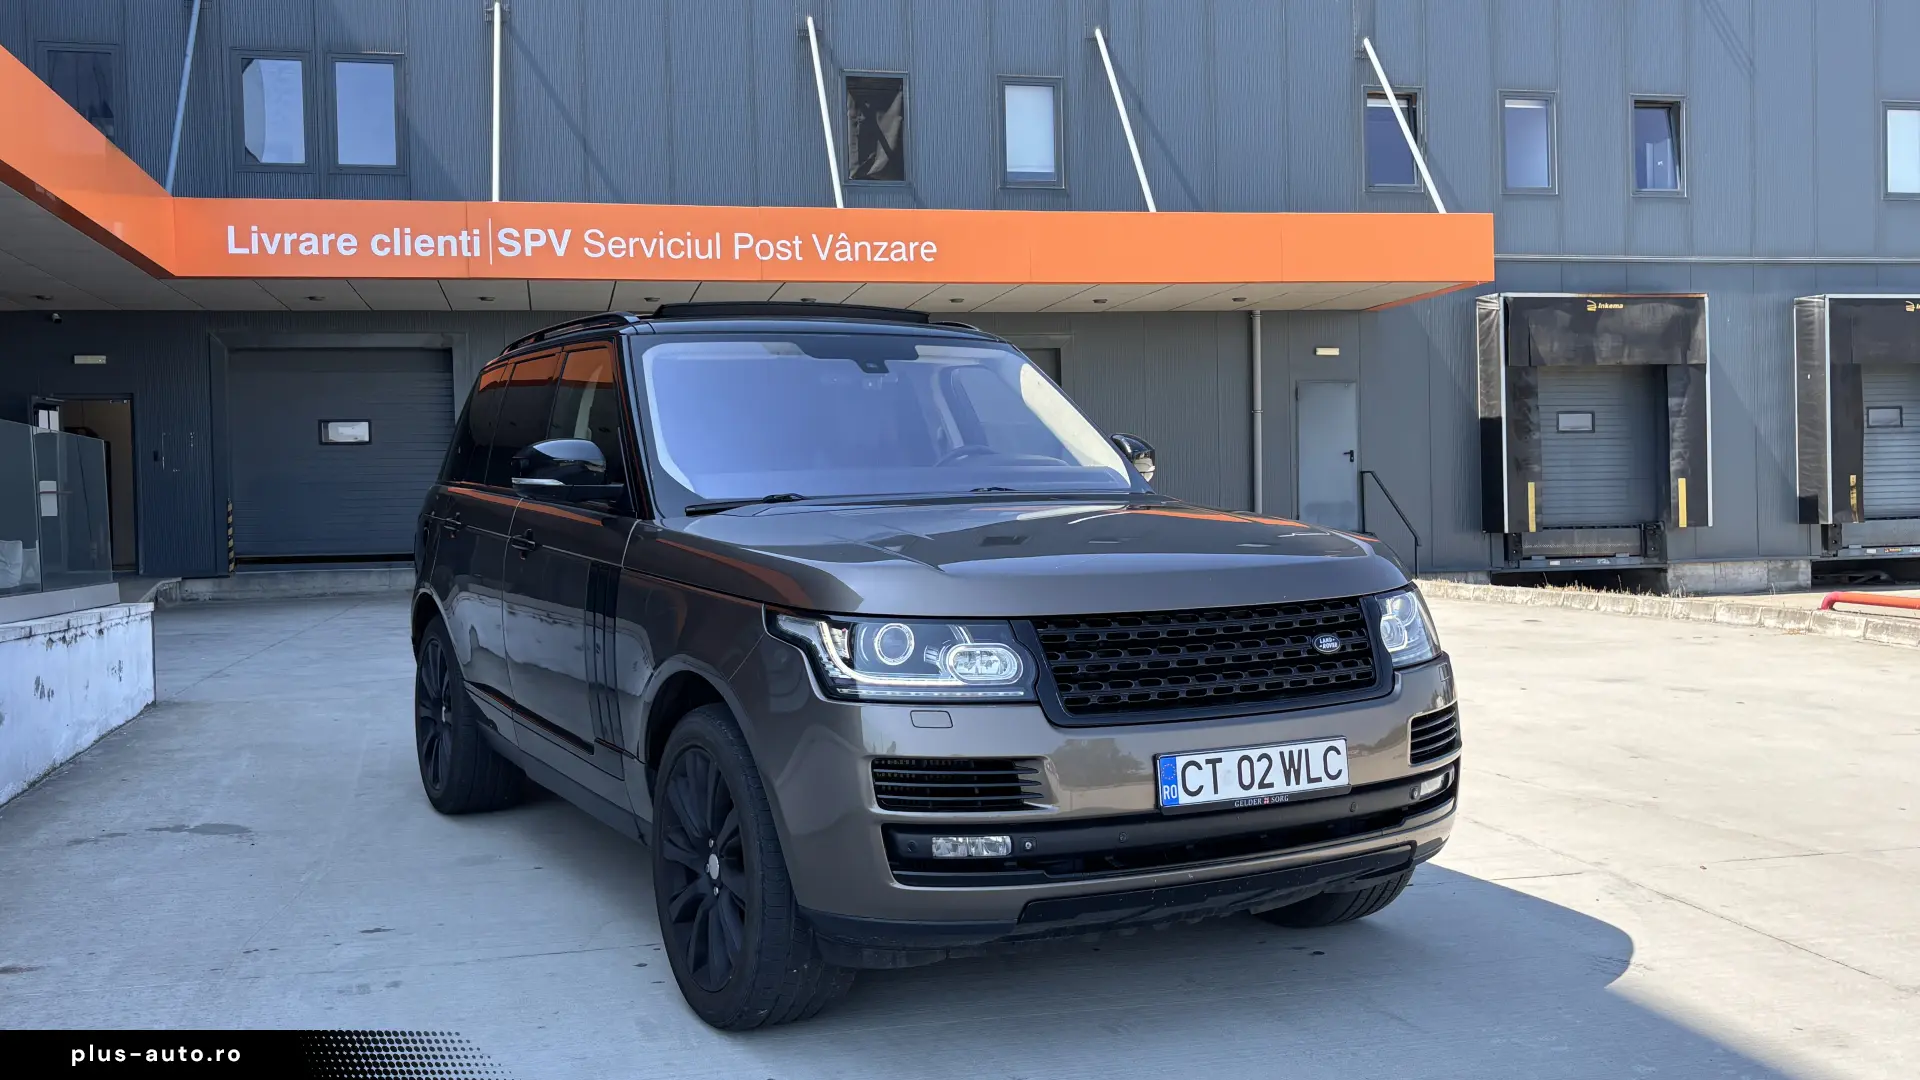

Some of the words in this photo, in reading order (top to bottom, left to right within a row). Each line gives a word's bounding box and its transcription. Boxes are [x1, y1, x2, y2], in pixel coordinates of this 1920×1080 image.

[227, 225, 358, 256] Livrare
[370, 227, 481, 257] clienti
[497, 228, 572, 258] SPV
[583, 229, 721, 260] Serviciul
[733, 232, 804, 261] Post
[811, 233, 938, 263] Vânzare
[1180, 757, 1223, 797] CT
[1237, 752, 1275, 791] 02
[1279, 745, 1343, 787] WLC
[1163, 784, 1178, 800] RO
[1234, 797, 1262, 807] GELDER
[1271, 794, 1289, 803] SORG
